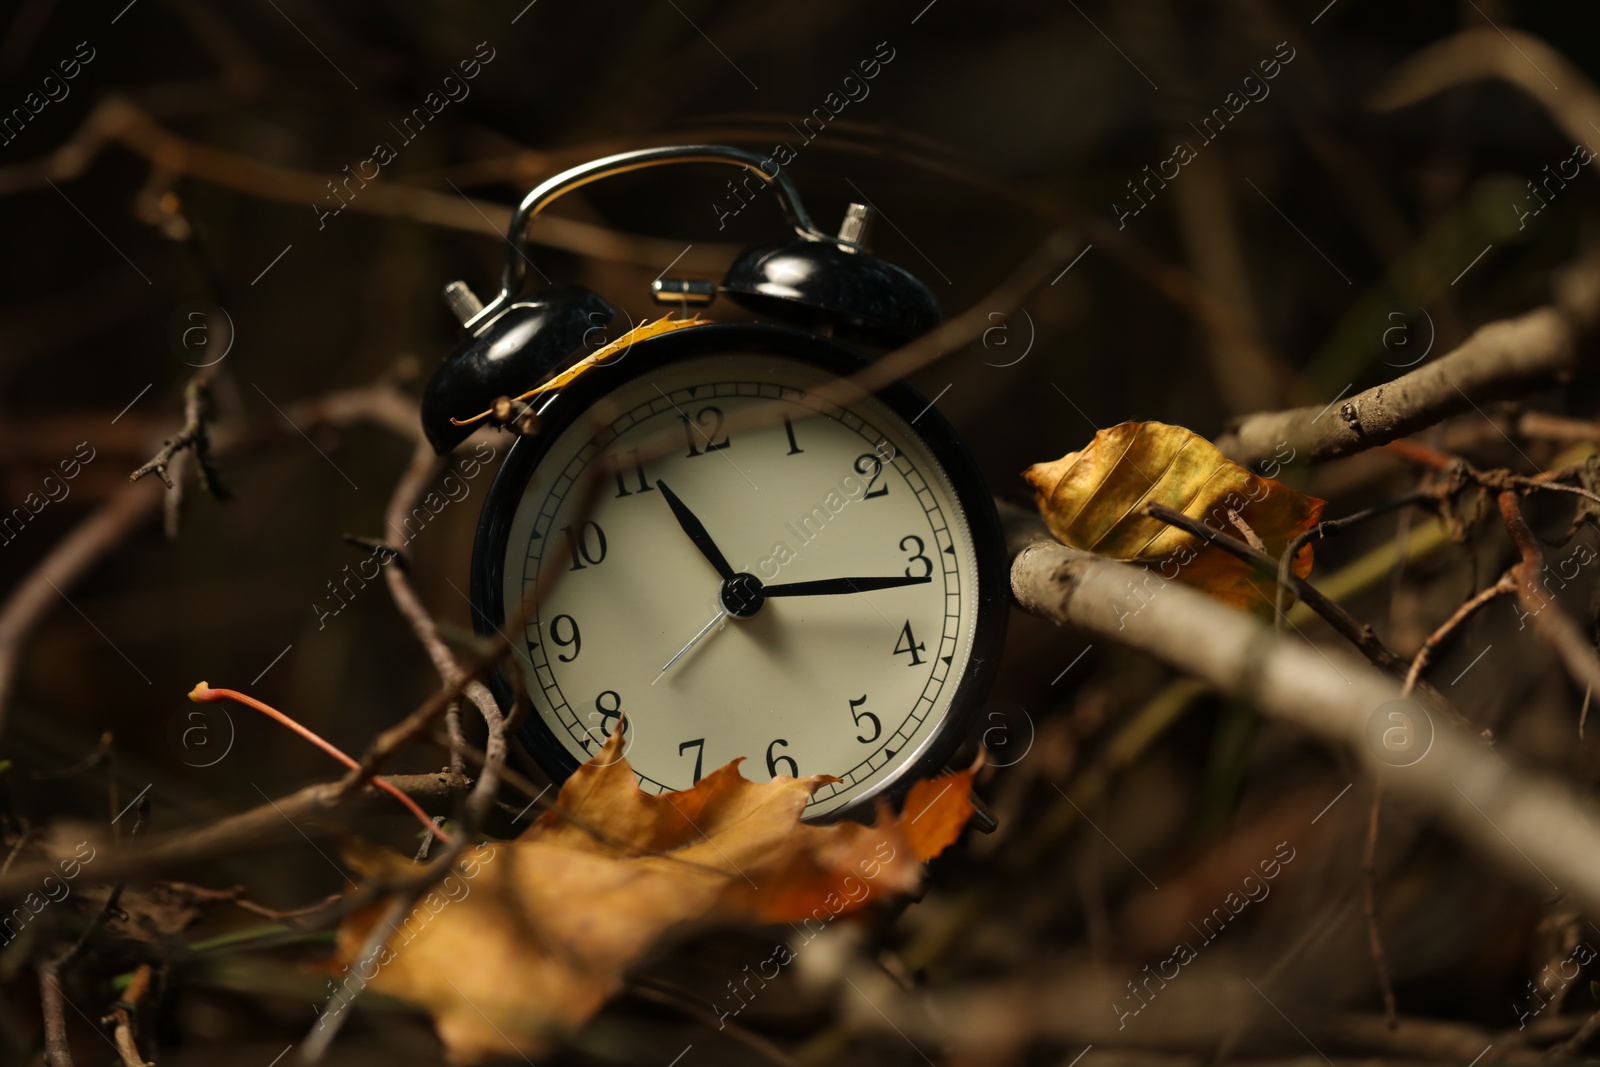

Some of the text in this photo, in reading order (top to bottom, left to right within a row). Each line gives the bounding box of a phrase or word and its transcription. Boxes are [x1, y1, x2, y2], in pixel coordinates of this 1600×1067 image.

[677, 406, 731, 458] 12
[778, 410, 805, 456] 1
[606, 447, 655, 499] 11
[854, 453, 889, 501] 2
[560, 520, 609, 572] 10
[898, 535, 934, 578] 3
[549, 614, 582, 662] 9
[893, 618, 927, 667] 4
[595, 690, 629, 738] 8
[848, 694, 882, 744] 5
[679, 738, 705, 787] 7
[766, 739, 799, 779] 6
